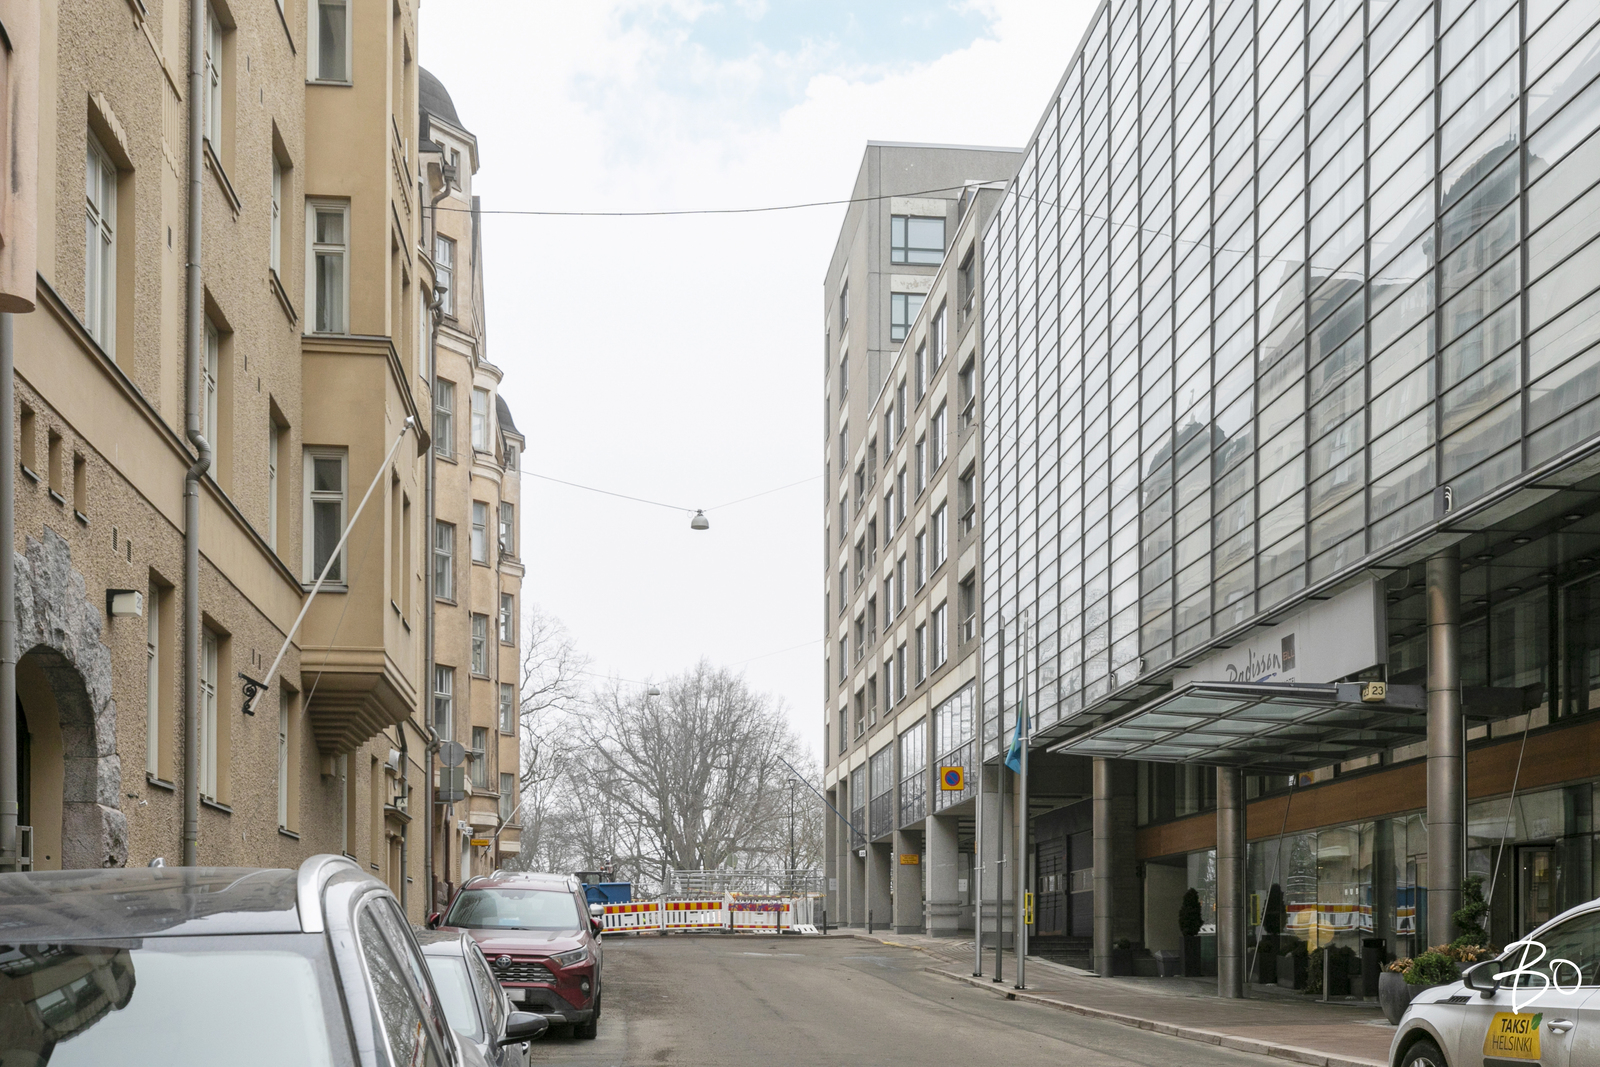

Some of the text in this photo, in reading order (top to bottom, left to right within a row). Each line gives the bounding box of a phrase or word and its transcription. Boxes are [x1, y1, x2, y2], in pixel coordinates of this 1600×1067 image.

[1225, 647, 1281, 682] Radisson
[1372, 685, 1384, 695] 23
[1501, 1018, 1530, 1034] TAKSI
[1492, 1035, 1533, 1052] HELSINKI
